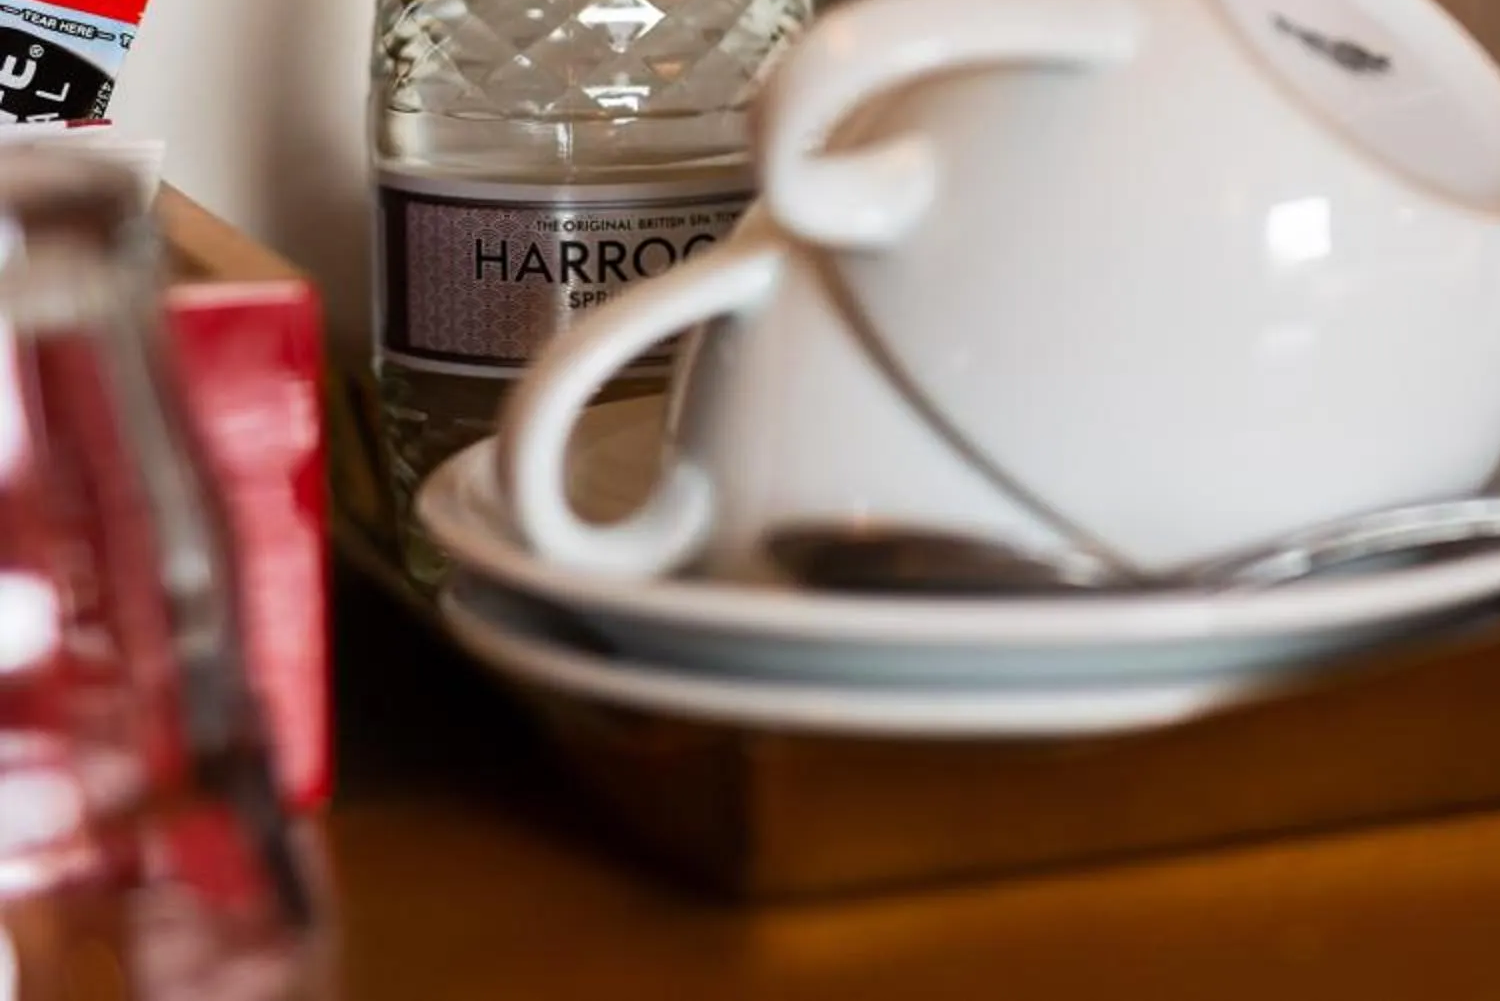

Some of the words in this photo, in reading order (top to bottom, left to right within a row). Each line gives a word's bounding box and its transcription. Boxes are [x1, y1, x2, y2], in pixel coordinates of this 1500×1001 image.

[23, 9, 57, 29] TEAR
[59, 19, 96, 39] HERE
[537, 220, 559, 232] THE
[563, 218, 633, 233] ORIGINAL
[638, 216, 685, 230] BRITISH
[569, 290, 609, 309] SPR
